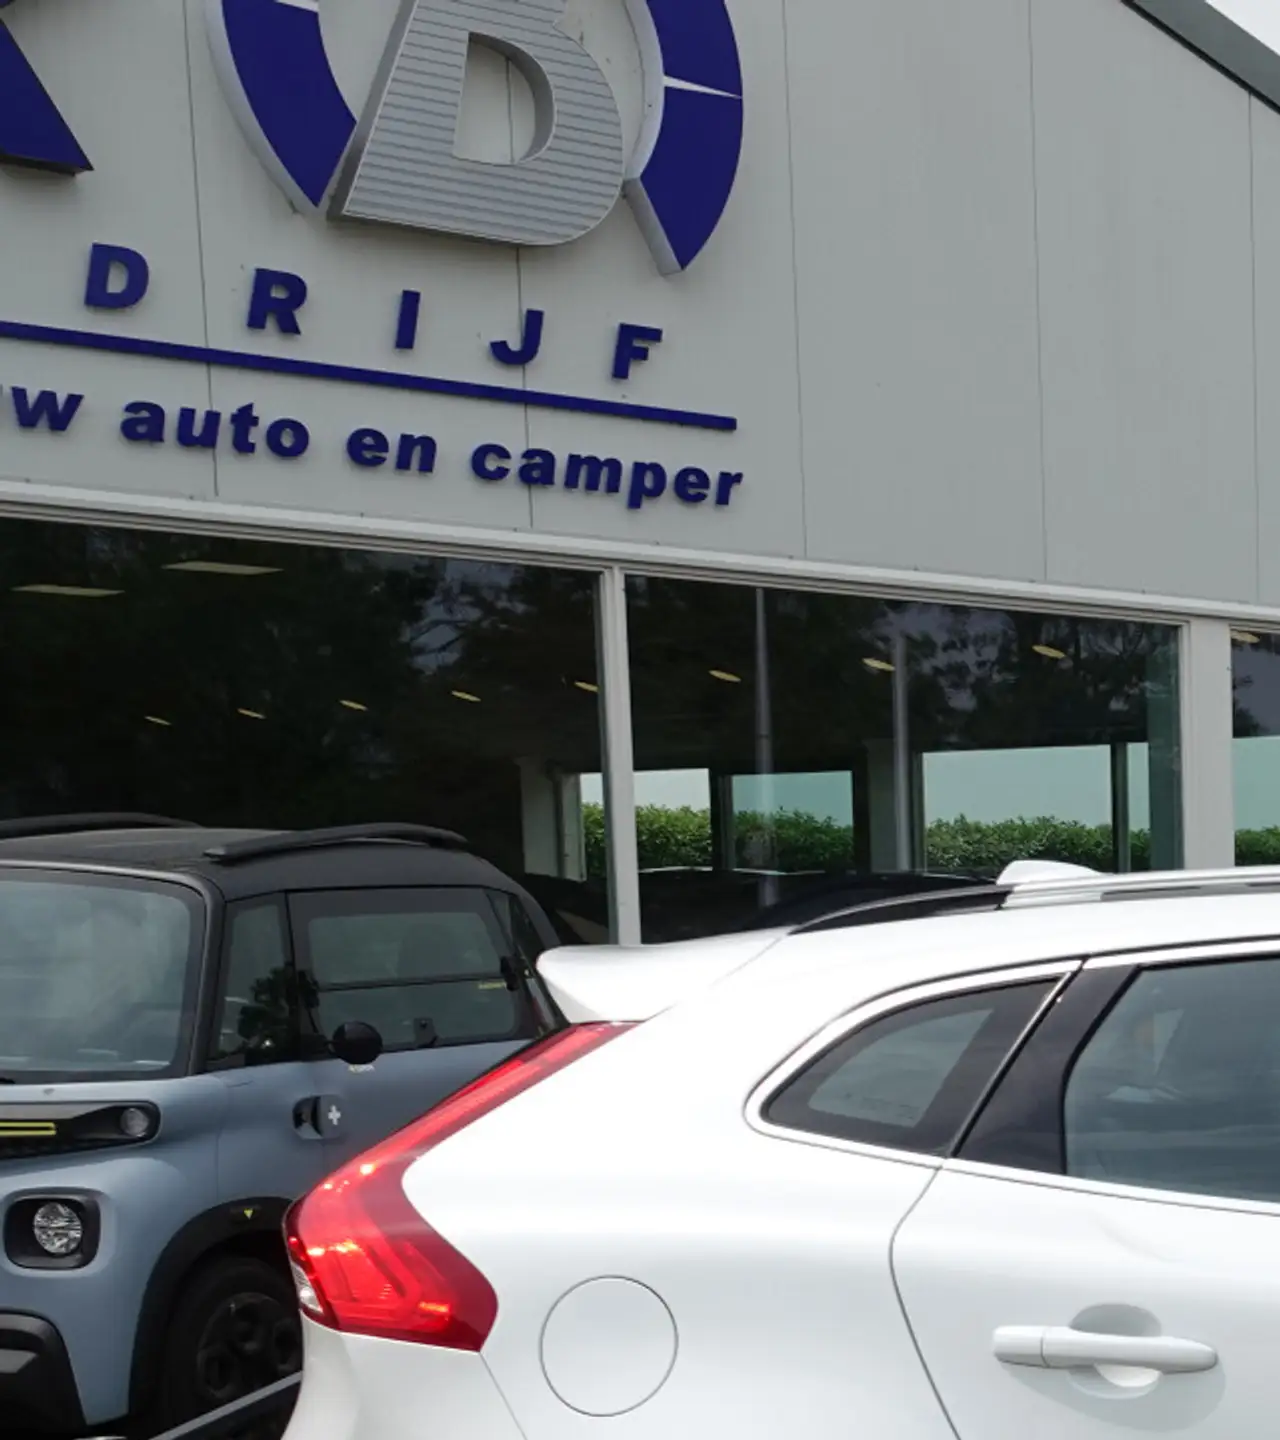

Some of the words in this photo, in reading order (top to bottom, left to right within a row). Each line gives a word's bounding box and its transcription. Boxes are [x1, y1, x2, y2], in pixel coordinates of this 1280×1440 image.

[120, 401, 310, 458] auto
[346, 428, 438, 473] en
[470, 443, 743, 509] camper
